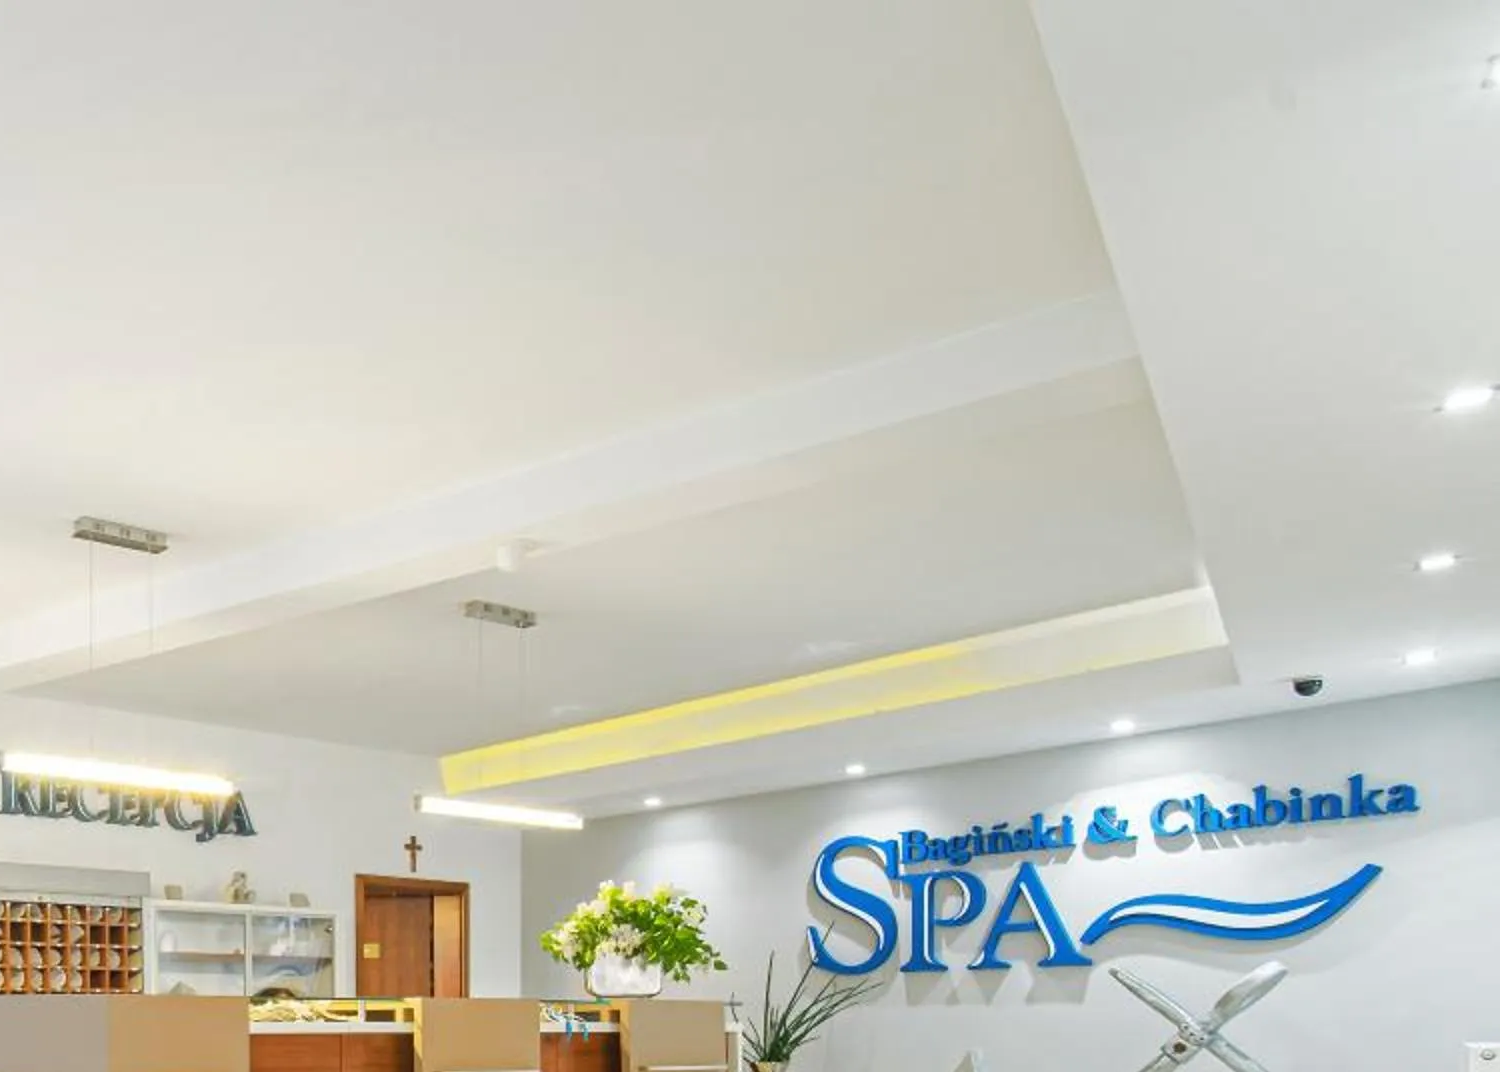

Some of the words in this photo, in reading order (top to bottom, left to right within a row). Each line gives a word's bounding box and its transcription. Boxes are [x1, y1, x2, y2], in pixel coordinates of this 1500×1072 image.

[901, 813, 1075, 866] Bagiński
[1088, 806, 1137, 843] &
[1150, 773, 1420, 837] Chabinka
[806, 835, 1094, 975] SPA
